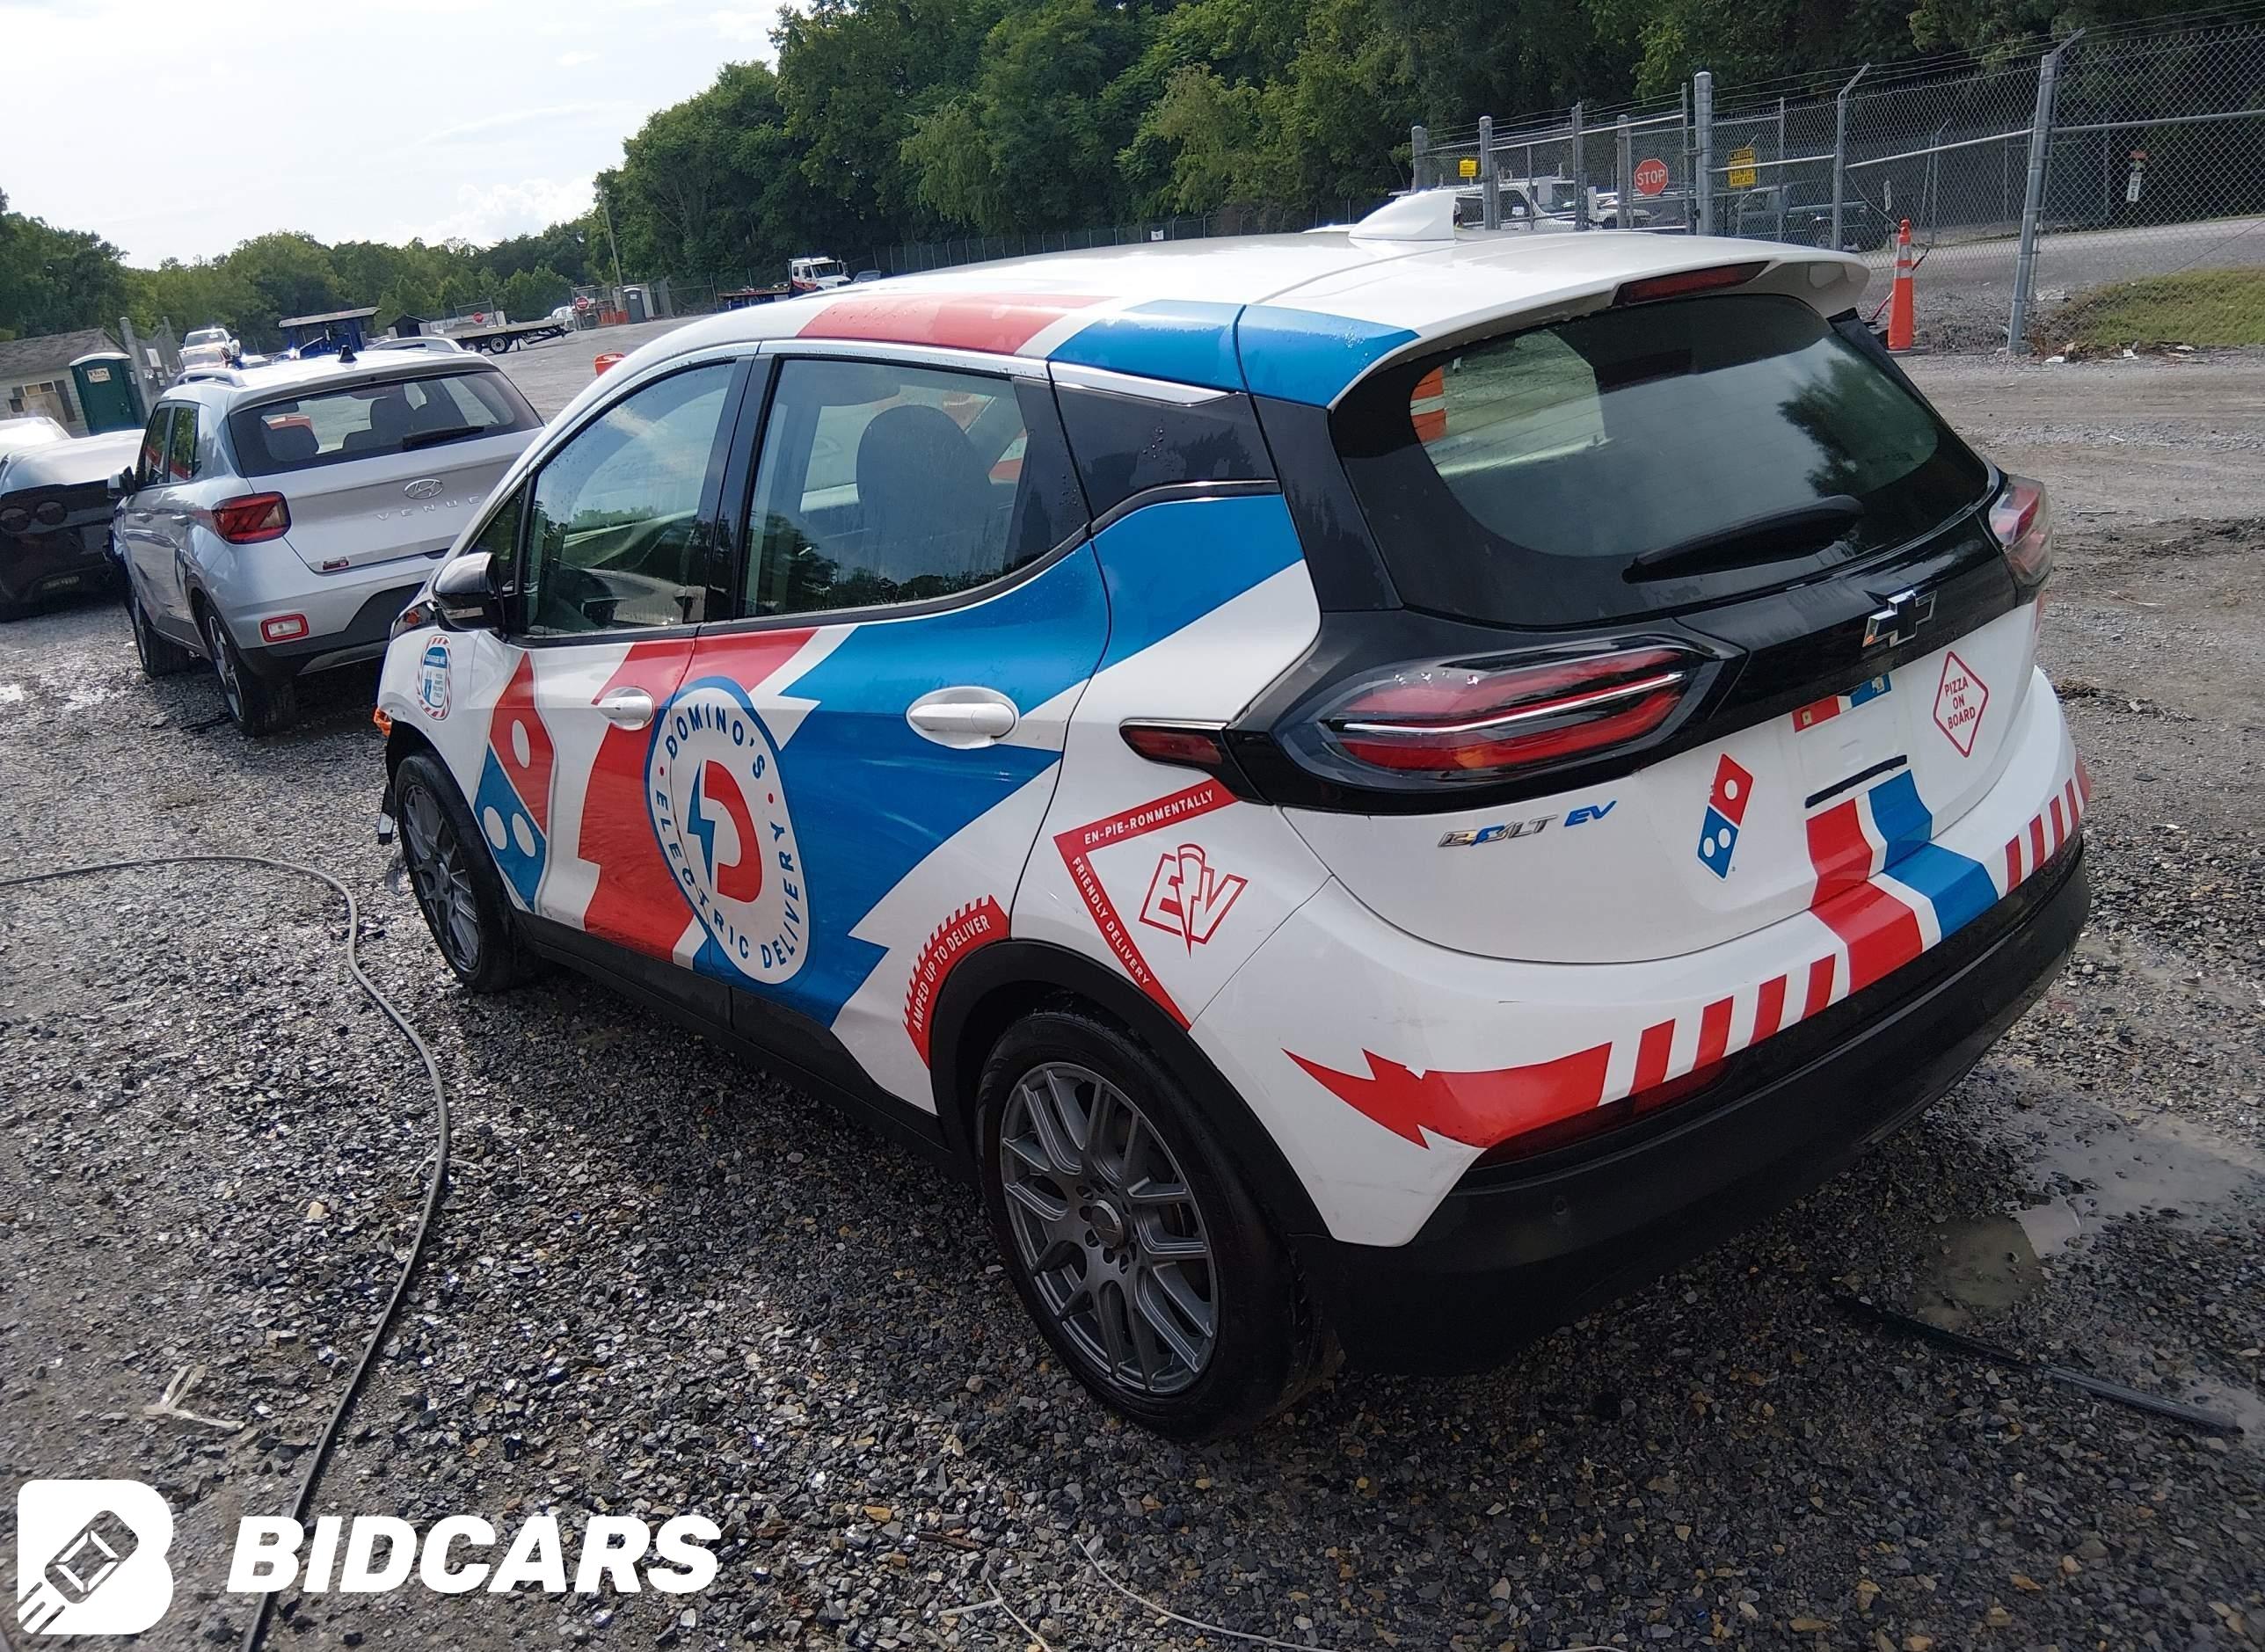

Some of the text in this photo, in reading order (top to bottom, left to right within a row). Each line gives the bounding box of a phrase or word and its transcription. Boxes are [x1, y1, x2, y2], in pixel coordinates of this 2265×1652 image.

[1636, 169, 1666, 186] STOP
[375, 495, 480, 521] VENUE
[1944, 676, 1969, 697] PIZZA
[1952, 694, 1966, 710] ON
[665, 702, 767, 780] DOMINO'S
[1947, 706, 1977, 730] BOARD
[1083, 789, 1214, 846] EN-PIE-RONMENTALLY
[1438, 800, 1618, 848] BOLT EV
[655, 789, 801, 969] ELECTRIC DELIVERY
[1072, 856, 1151, 986] FRIENDLY DELIVERY
[912, 914, 992, 1033] AMPED UP TO DELIVER
